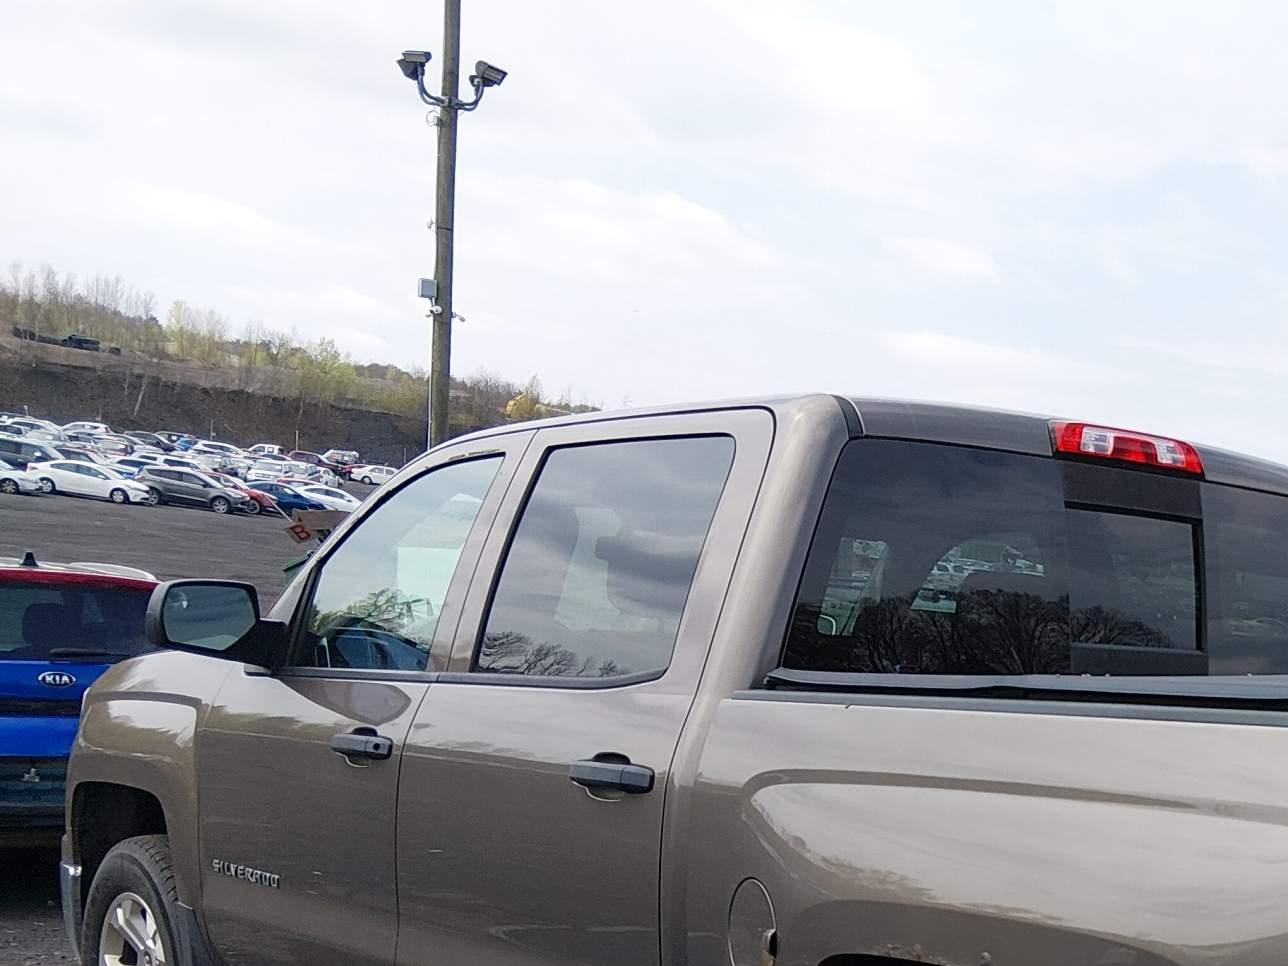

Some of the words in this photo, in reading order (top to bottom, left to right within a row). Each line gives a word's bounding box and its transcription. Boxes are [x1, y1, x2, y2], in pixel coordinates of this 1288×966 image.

[289, 524, 311, 540] B
[44, 674, 71, 685] KIA
[211, 859, 280, 887] SILVERADO
